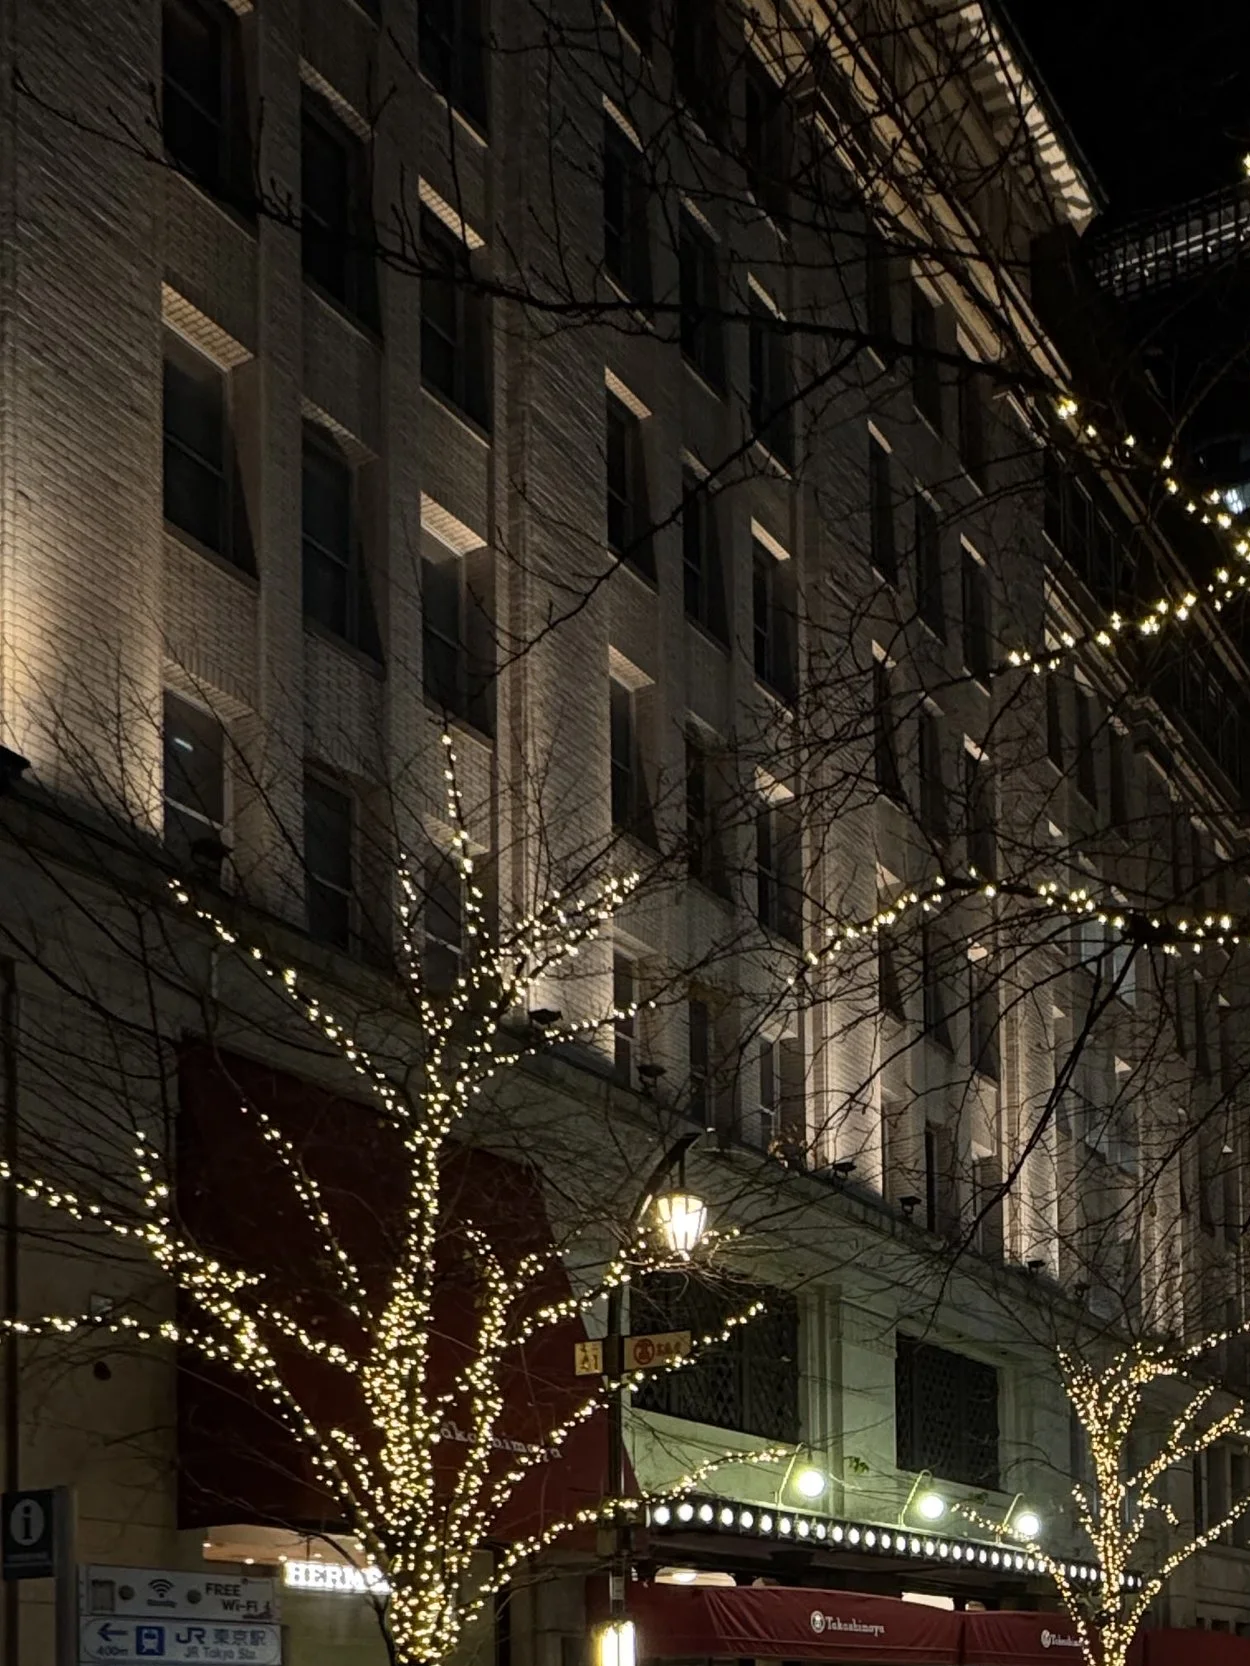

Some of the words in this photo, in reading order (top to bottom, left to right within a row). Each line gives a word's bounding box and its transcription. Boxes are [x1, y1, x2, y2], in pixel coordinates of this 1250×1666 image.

[206, 1582, 241, 1598] FREE
[221, 1598, 258, 1612] Wi-Fi
[825, 1615, 886, 1638] Takashimaya
[176, 1627, 206, 1645] JR
[213, 1628, 266, 1646] 東京駅
[203, 1646, 235, 1660] Tokyo
